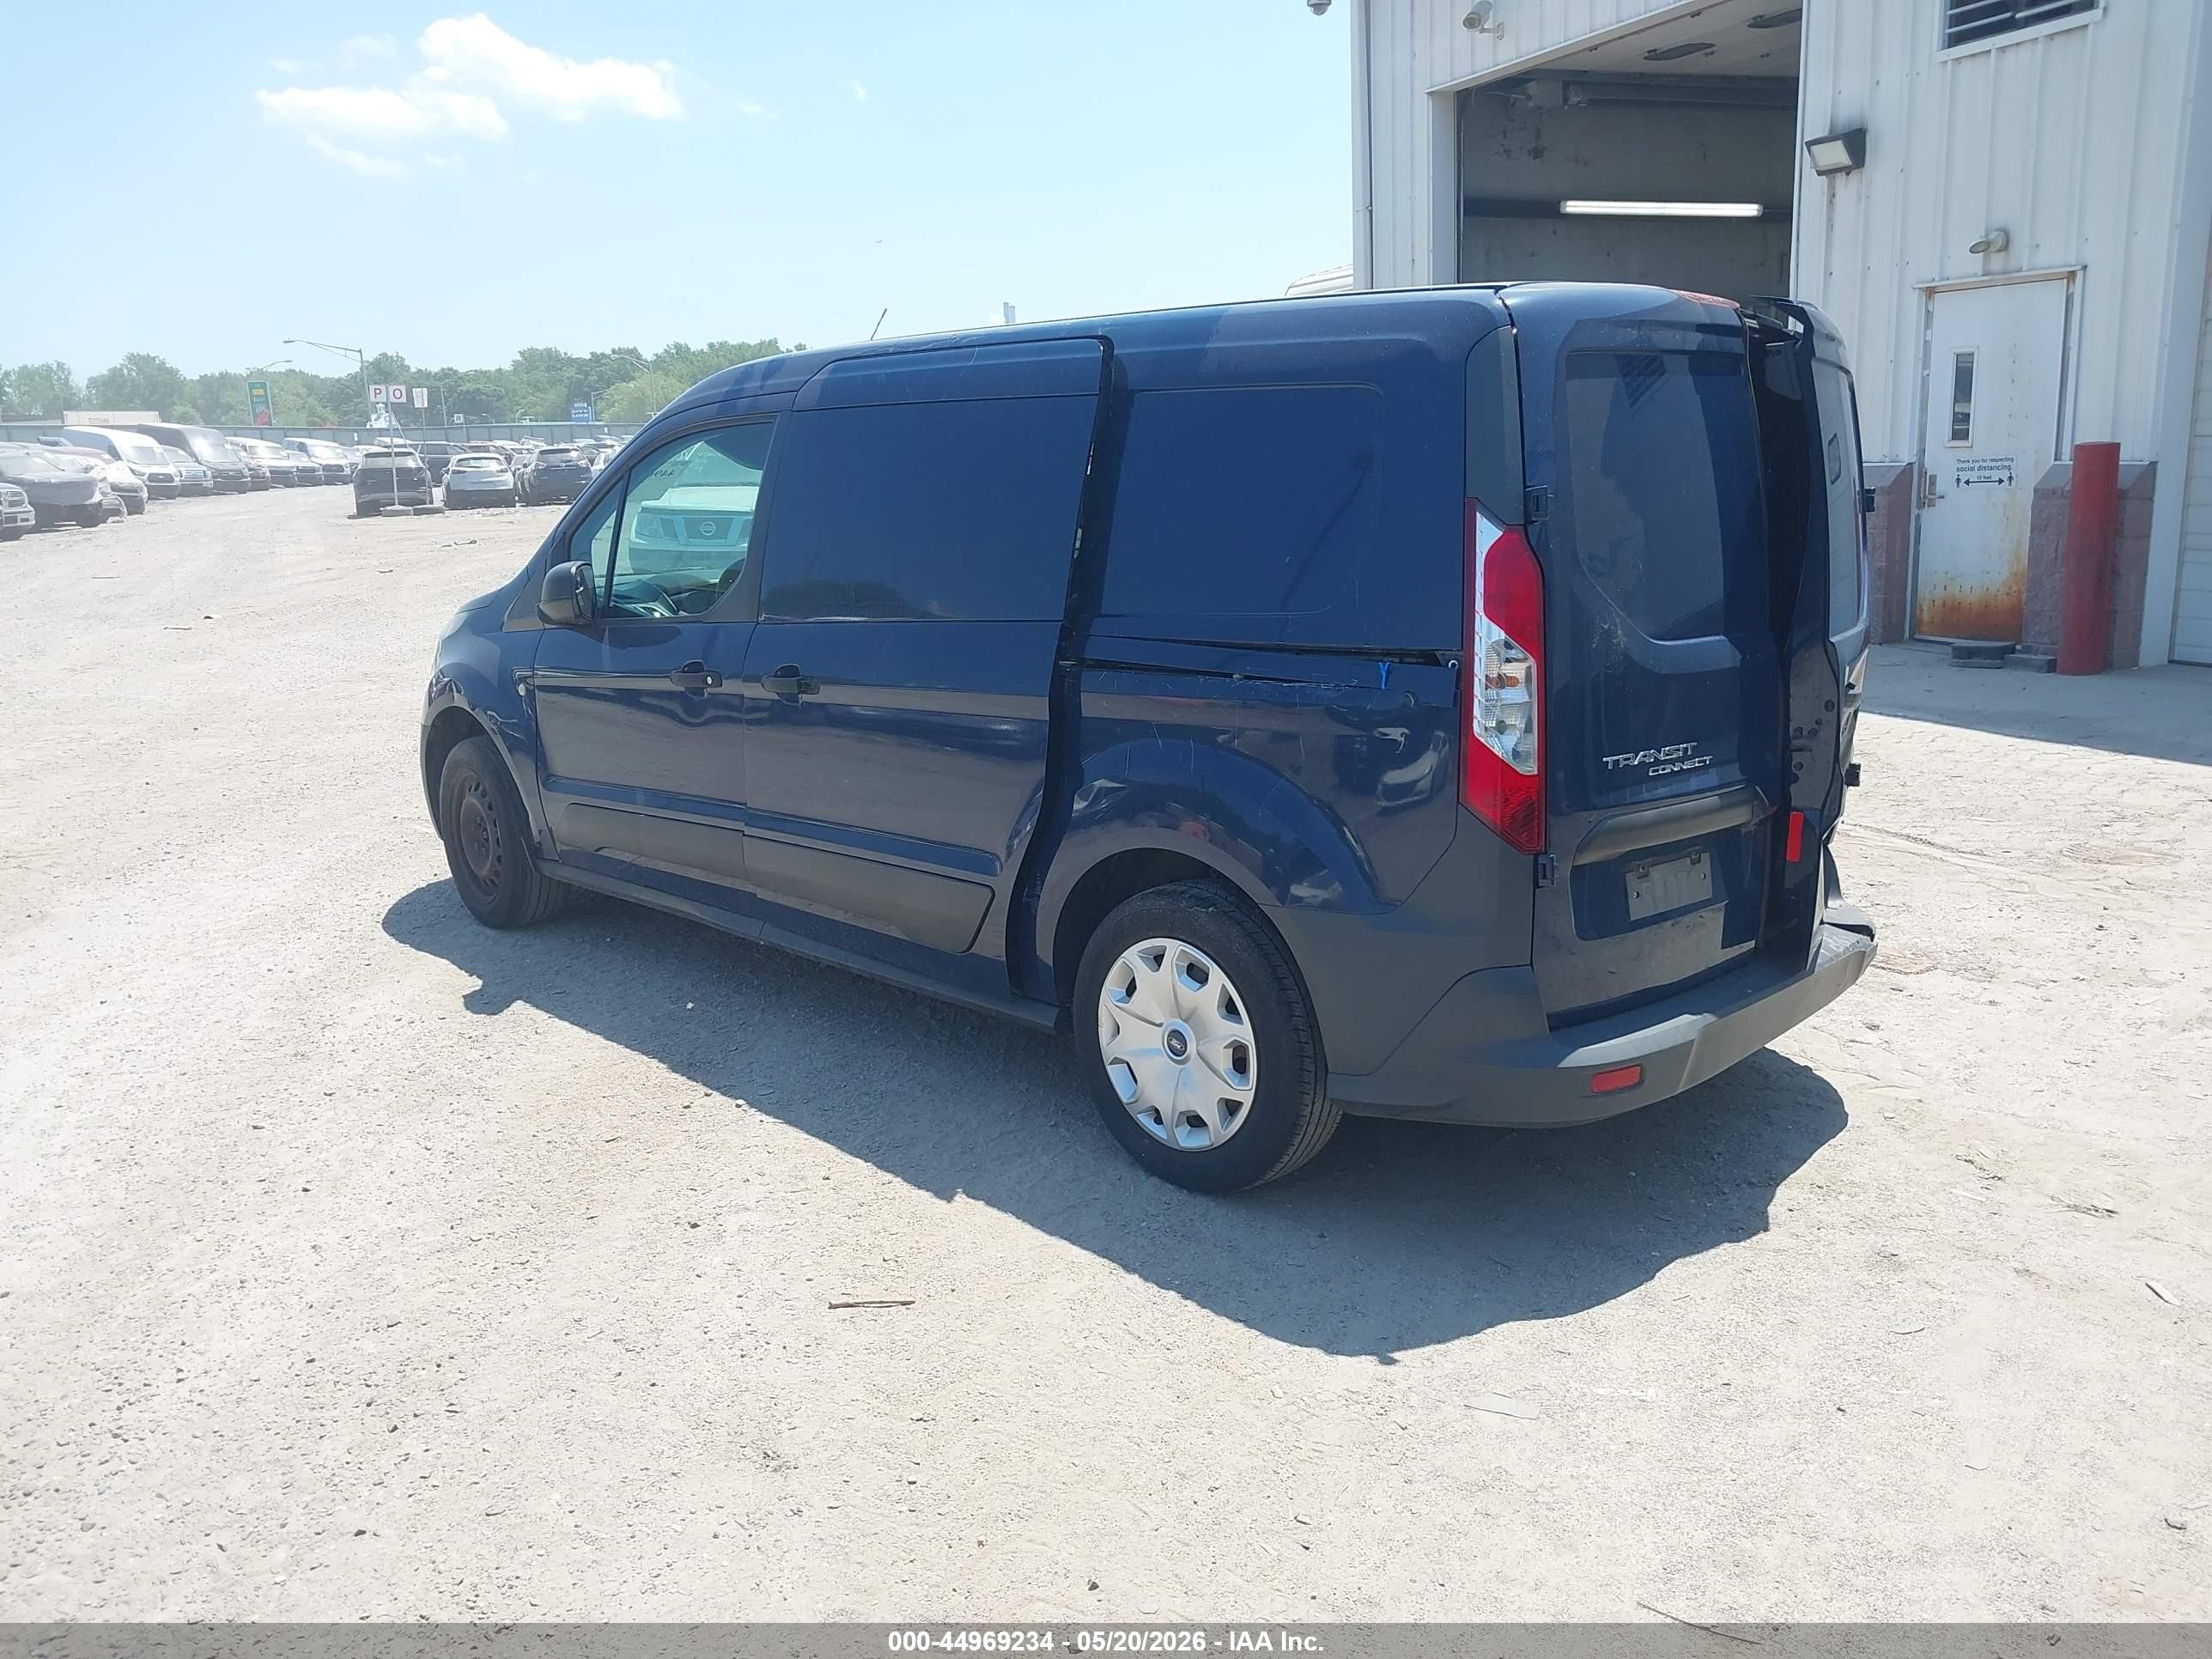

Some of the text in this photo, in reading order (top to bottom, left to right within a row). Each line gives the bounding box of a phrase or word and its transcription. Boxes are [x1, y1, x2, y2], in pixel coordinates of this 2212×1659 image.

[374, 388, 382, 399] P
[1977, 464, 2014, 472] distancing.
[1602, 742, 1698, 769] TRANSIT
[1648, 756, 1713, 776] CONNECT
